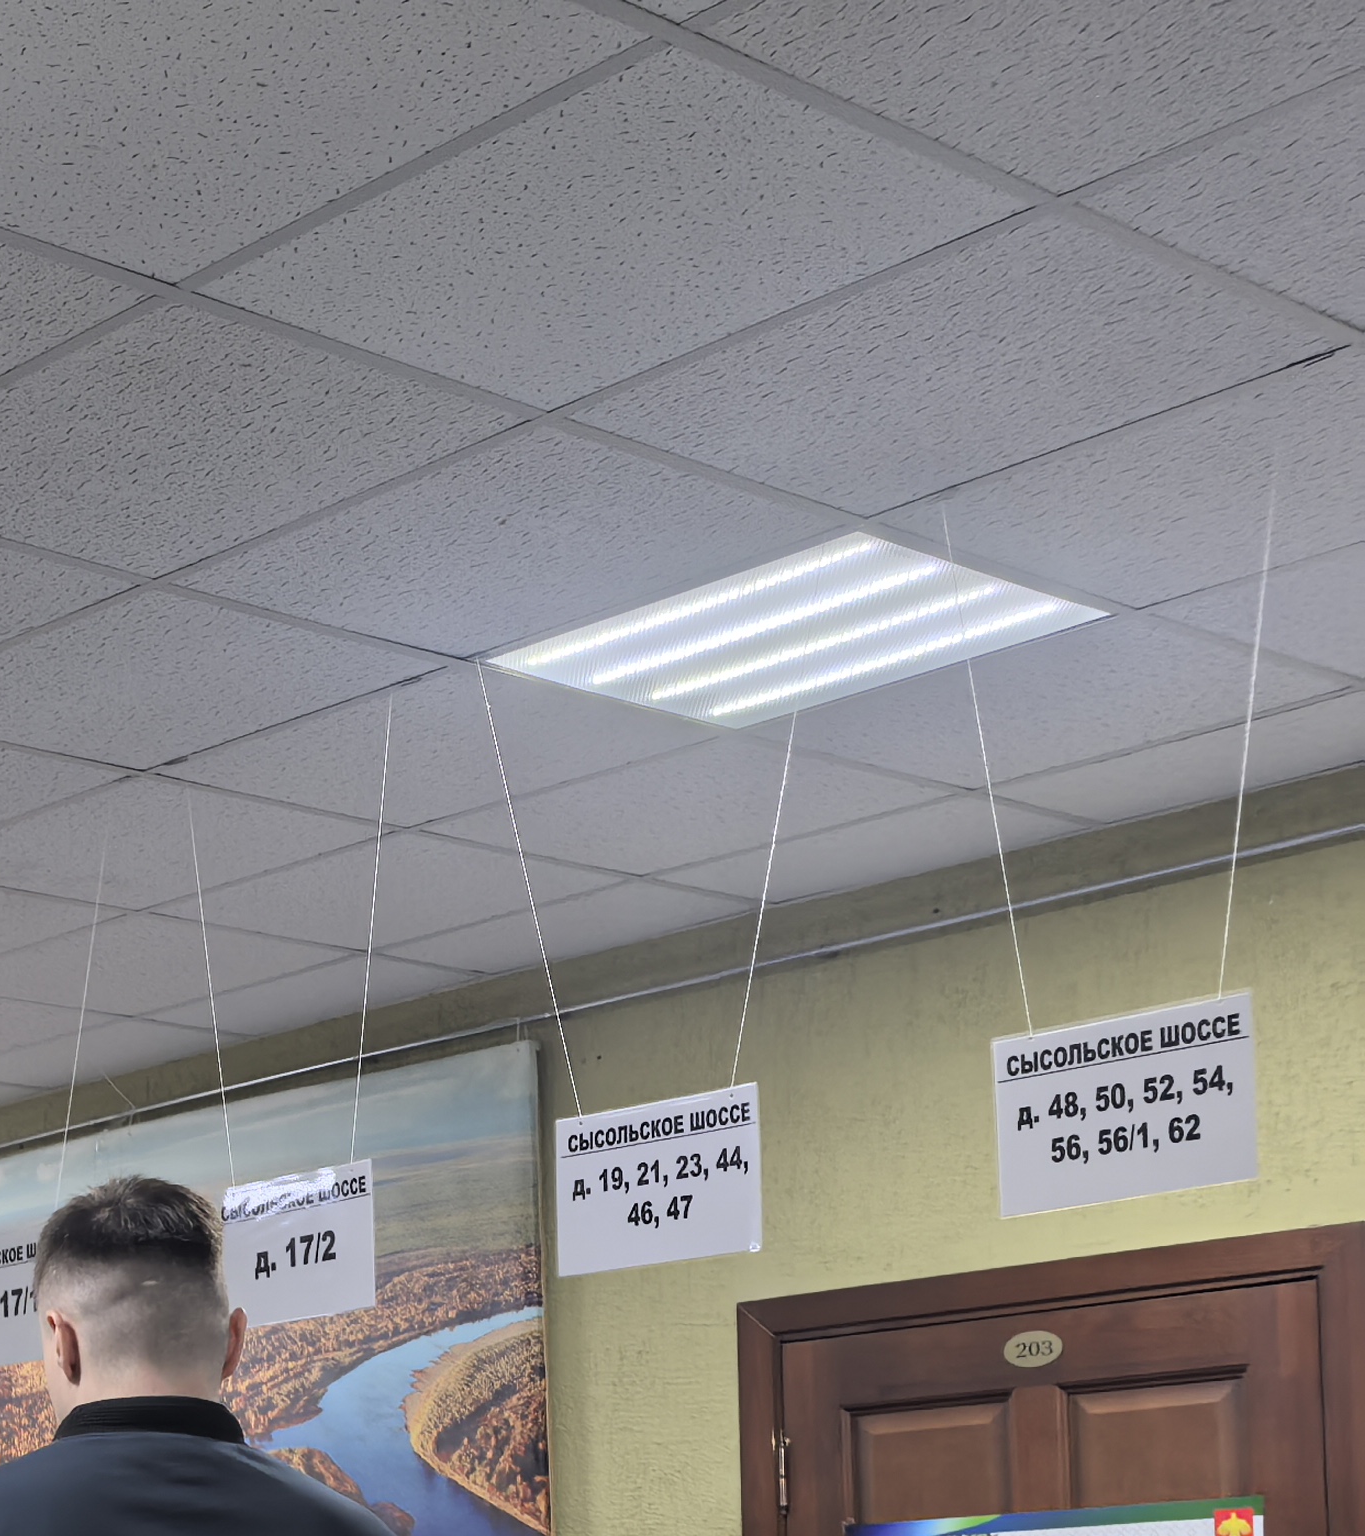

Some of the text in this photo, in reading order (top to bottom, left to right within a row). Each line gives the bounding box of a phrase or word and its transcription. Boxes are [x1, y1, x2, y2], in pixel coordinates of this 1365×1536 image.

[1006, 1013, 1240, 1076] СЫСОЛЬСКОЕ ШОССЕ
[1018, 1065, 1233, 1131] д. 48, 50, 52, 54,
[568, 1102, 751, 1152] СЫСОЛЬСКОЕ ШОССЕ
[1051, 1114, 1201, 1164] 56, 56/1, 62
[572, 1145, 748, 1201] д. 19, 21, 23, 44,
[627, 1195, 693, 1229] 46, 47
[255, 1230, 336, 1280] д. 17/2
[1015, 1340, 1053, 1358] 203
